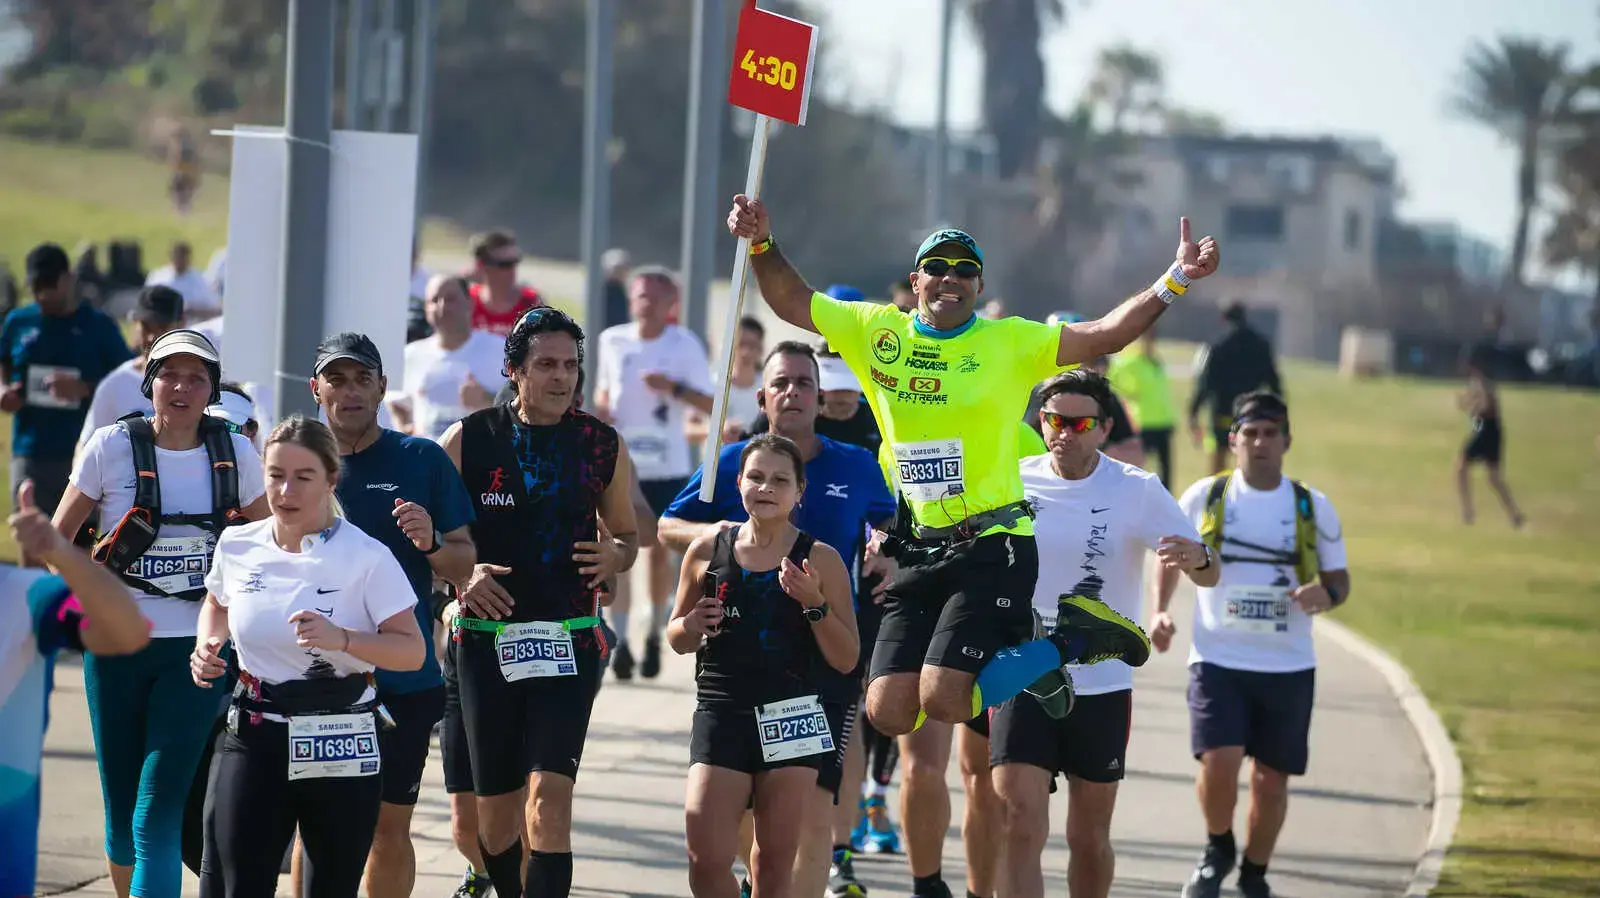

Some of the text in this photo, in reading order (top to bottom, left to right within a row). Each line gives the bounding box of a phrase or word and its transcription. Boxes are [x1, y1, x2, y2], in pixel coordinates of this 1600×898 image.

[741, 49, 797, 90] 4:30
[904, 357, 935, 370] HOKA
[898, 391, 948, 402] EXTREME
[910, 448, 941, 456] SAMSUNG
[911, 462, 942, 481] 3331
[145, 559, 184, 576] 1662
[519, 628, 550, 636] SAMSUNG
[518, 641, 553, 659] 3315
[782, 703, 811, 714] SAMSUNG
[318, 722, 353, 731] SAMSUNG
[782, 717, 816, 738] 2733
[316, 738, 355, 758] 1639
